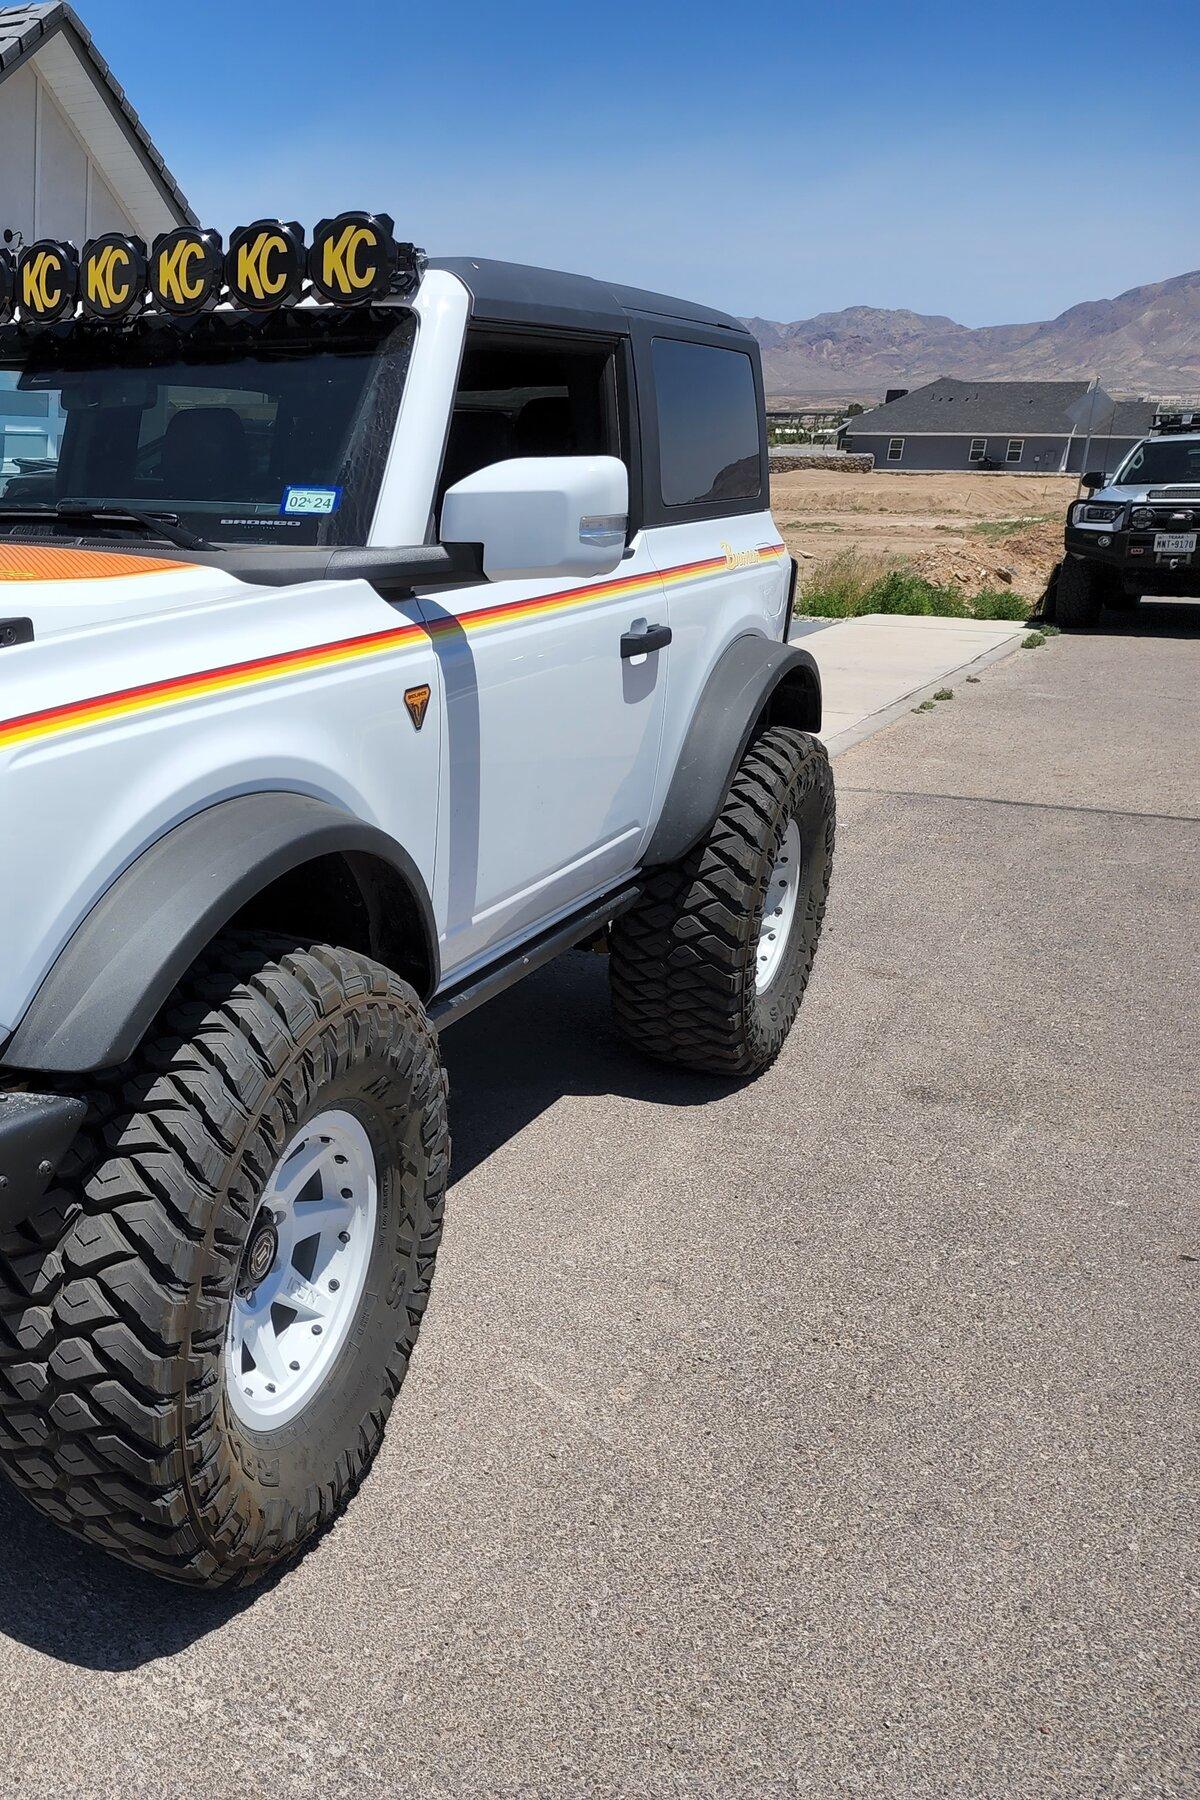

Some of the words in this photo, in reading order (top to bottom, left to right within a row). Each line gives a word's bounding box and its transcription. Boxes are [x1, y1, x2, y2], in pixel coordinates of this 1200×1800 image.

[23, 252, 61, 312] KC
[88, 246, 130, 309] KC
[159, 239, 205, 304] KC
[237, 233, 288, 299] KC
[323, 225, 377, 294] KC
